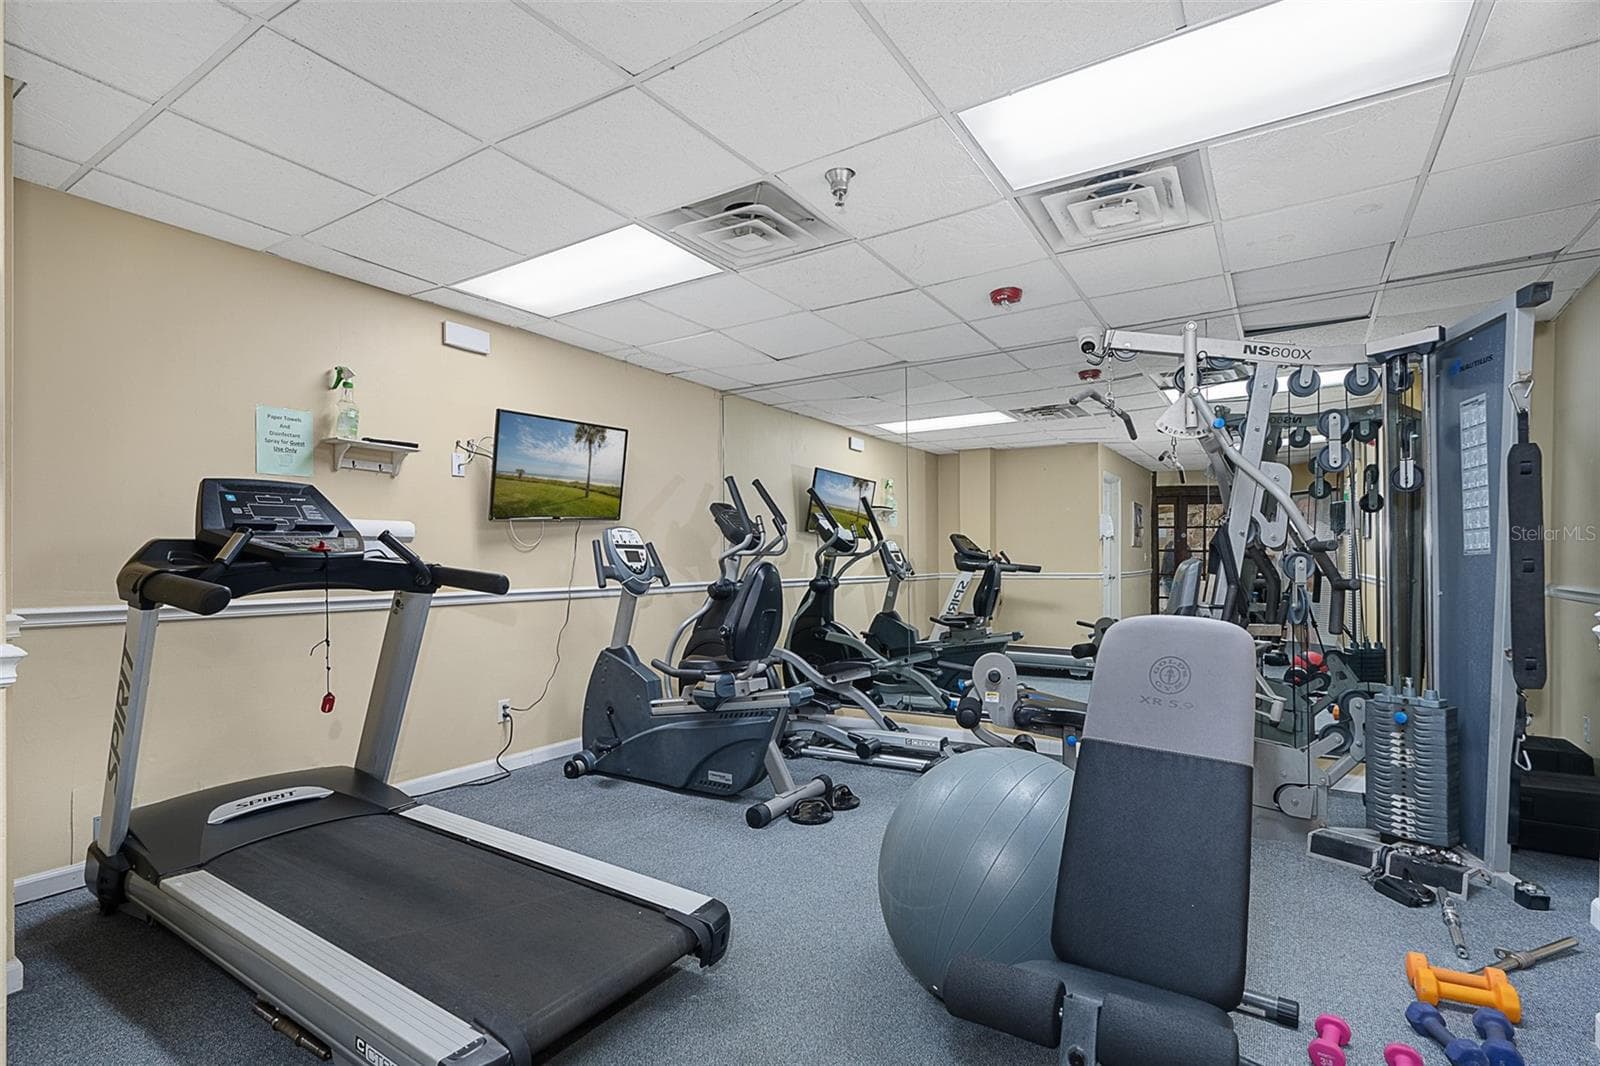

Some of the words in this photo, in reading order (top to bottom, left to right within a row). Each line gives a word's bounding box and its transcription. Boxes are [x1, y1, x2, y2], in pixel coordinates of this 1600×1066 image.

[1243, 344, 1312, 360] NS600X
[267, 413, 282, 421] Paper
[284, 415, 302, 423] Towels
[269, 430, 300, 438] Disinfectant
[1139, 695, 1163, 706] XR
[107, 631, 134, 795] SPIRIT
[235, 790, 297, 810] SPIRIT
